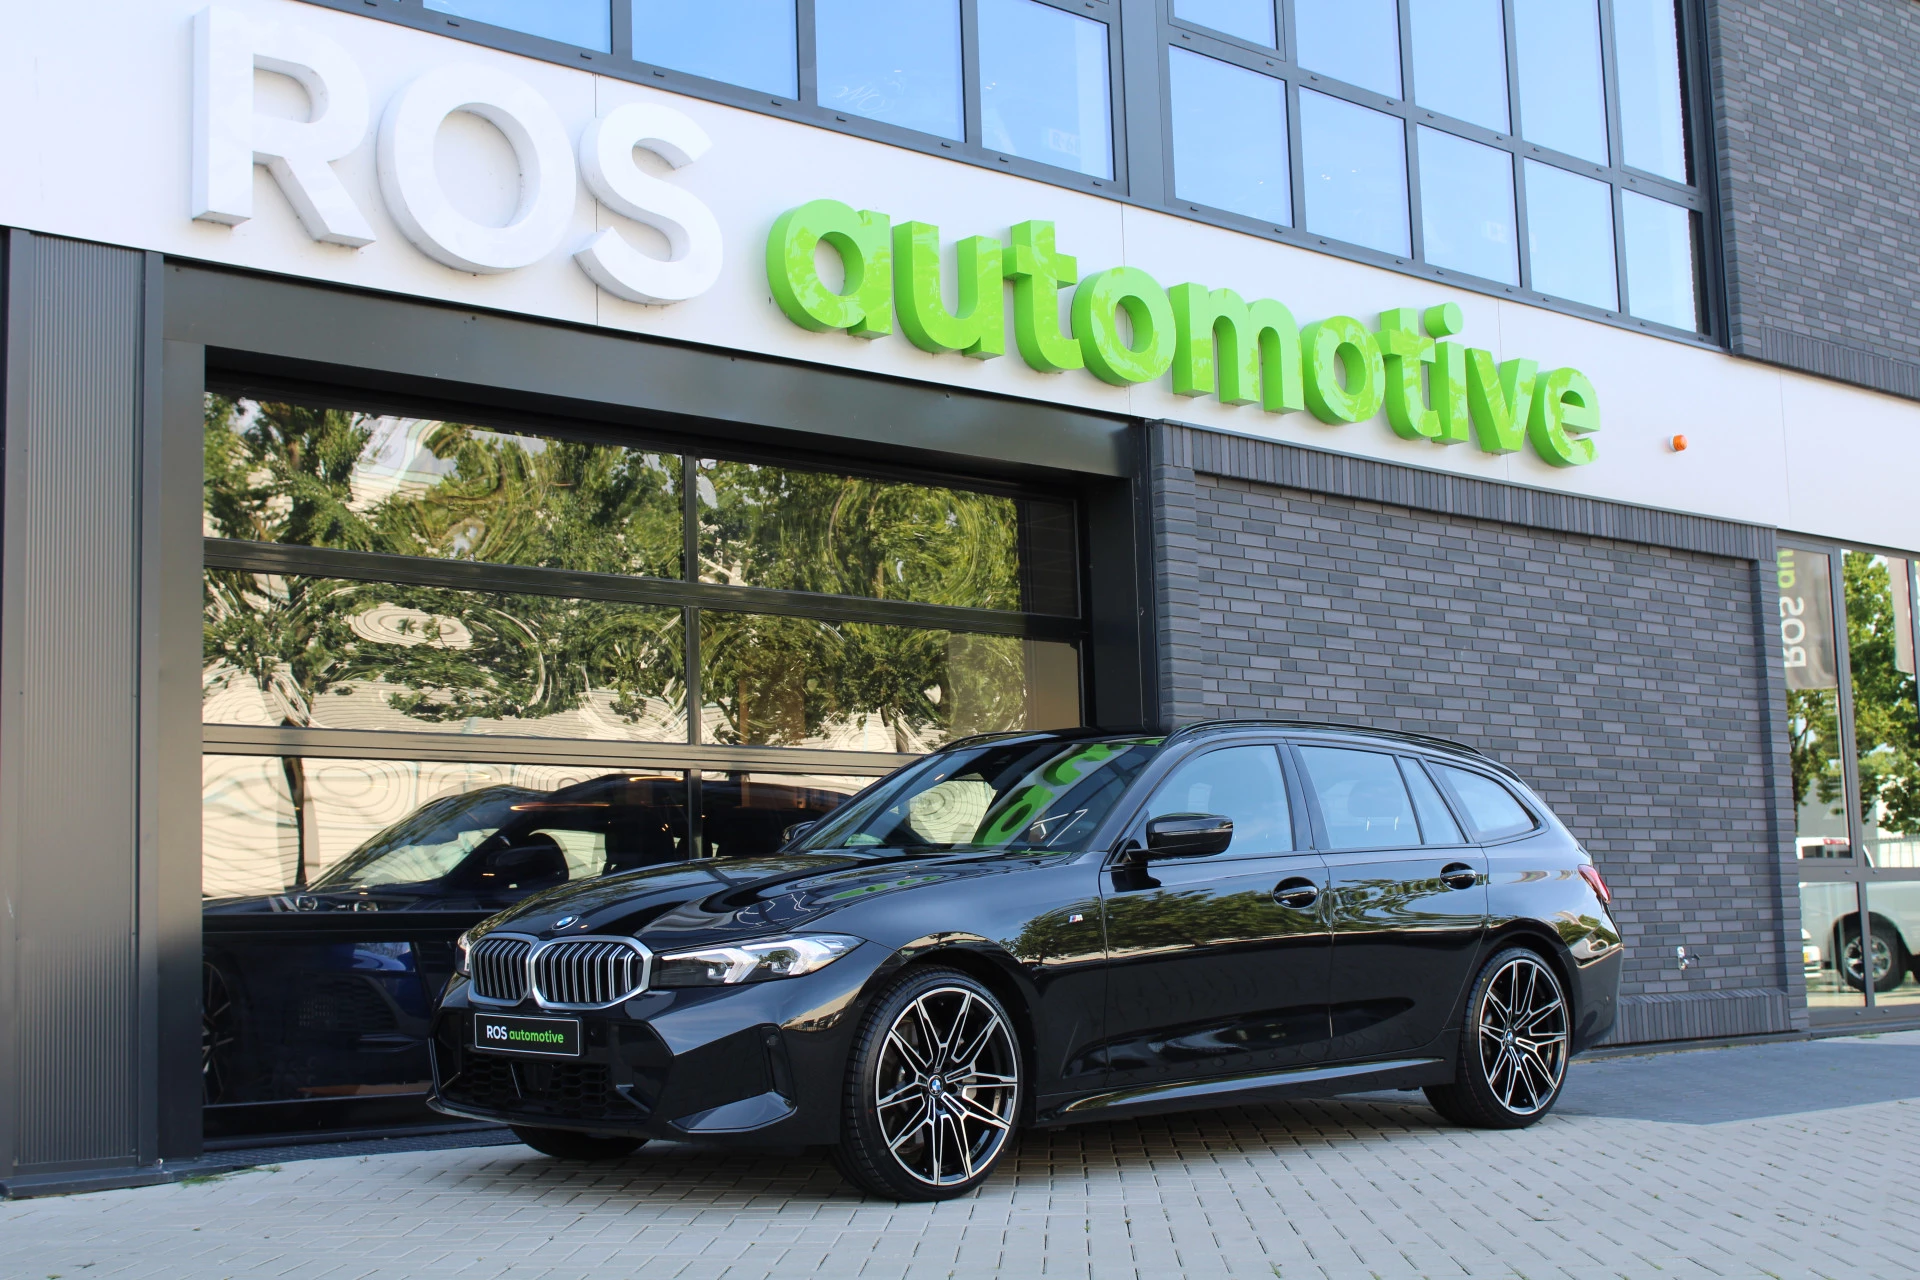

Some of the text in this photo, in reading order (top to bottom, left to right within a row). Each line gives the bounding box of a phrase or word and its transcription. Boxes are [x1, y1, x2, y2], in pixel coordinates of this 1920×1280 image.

[191, 5, 1600, 468] ROS automotive
[486, 1025, 564, 1043] ROS automotive
